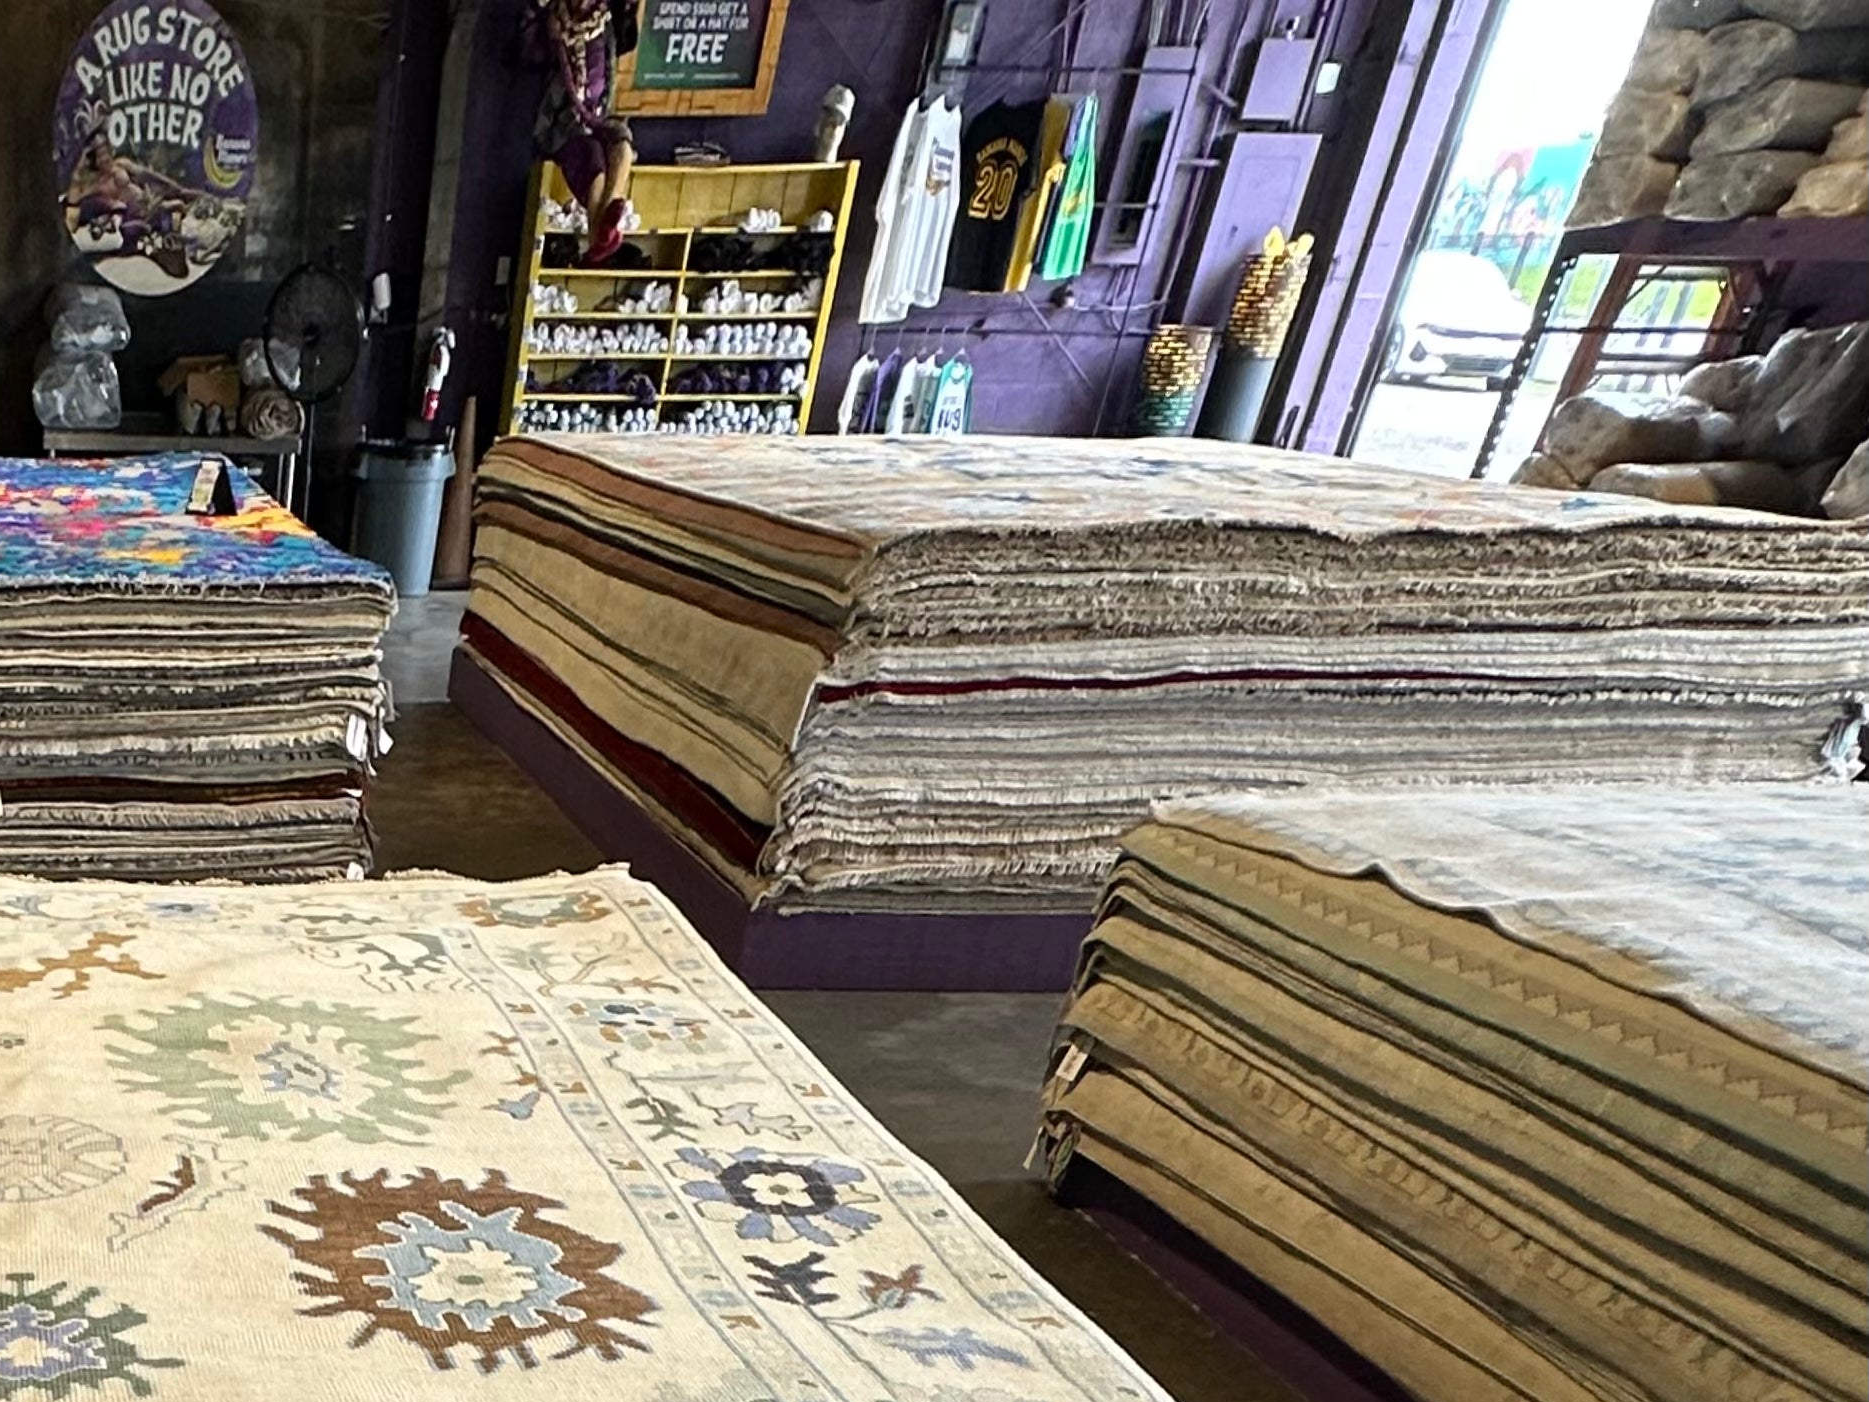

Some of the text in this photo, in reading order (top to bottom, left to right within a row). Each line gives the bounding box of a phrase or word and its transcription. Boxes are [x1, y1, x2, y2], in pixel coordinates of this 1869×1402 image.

[698, 18, 707, 29] A
[729, 18, 749, 30] FOR
[740, 3, 748, 15] A
[75, 6, 244, 98] A RUG STORE
[665, 33, 729, 64] FREE
[105, 61, 211, 106] LIKE NO
[107, 103, 203, 149] OTHER
[968, 157, 1018, 221] 20
